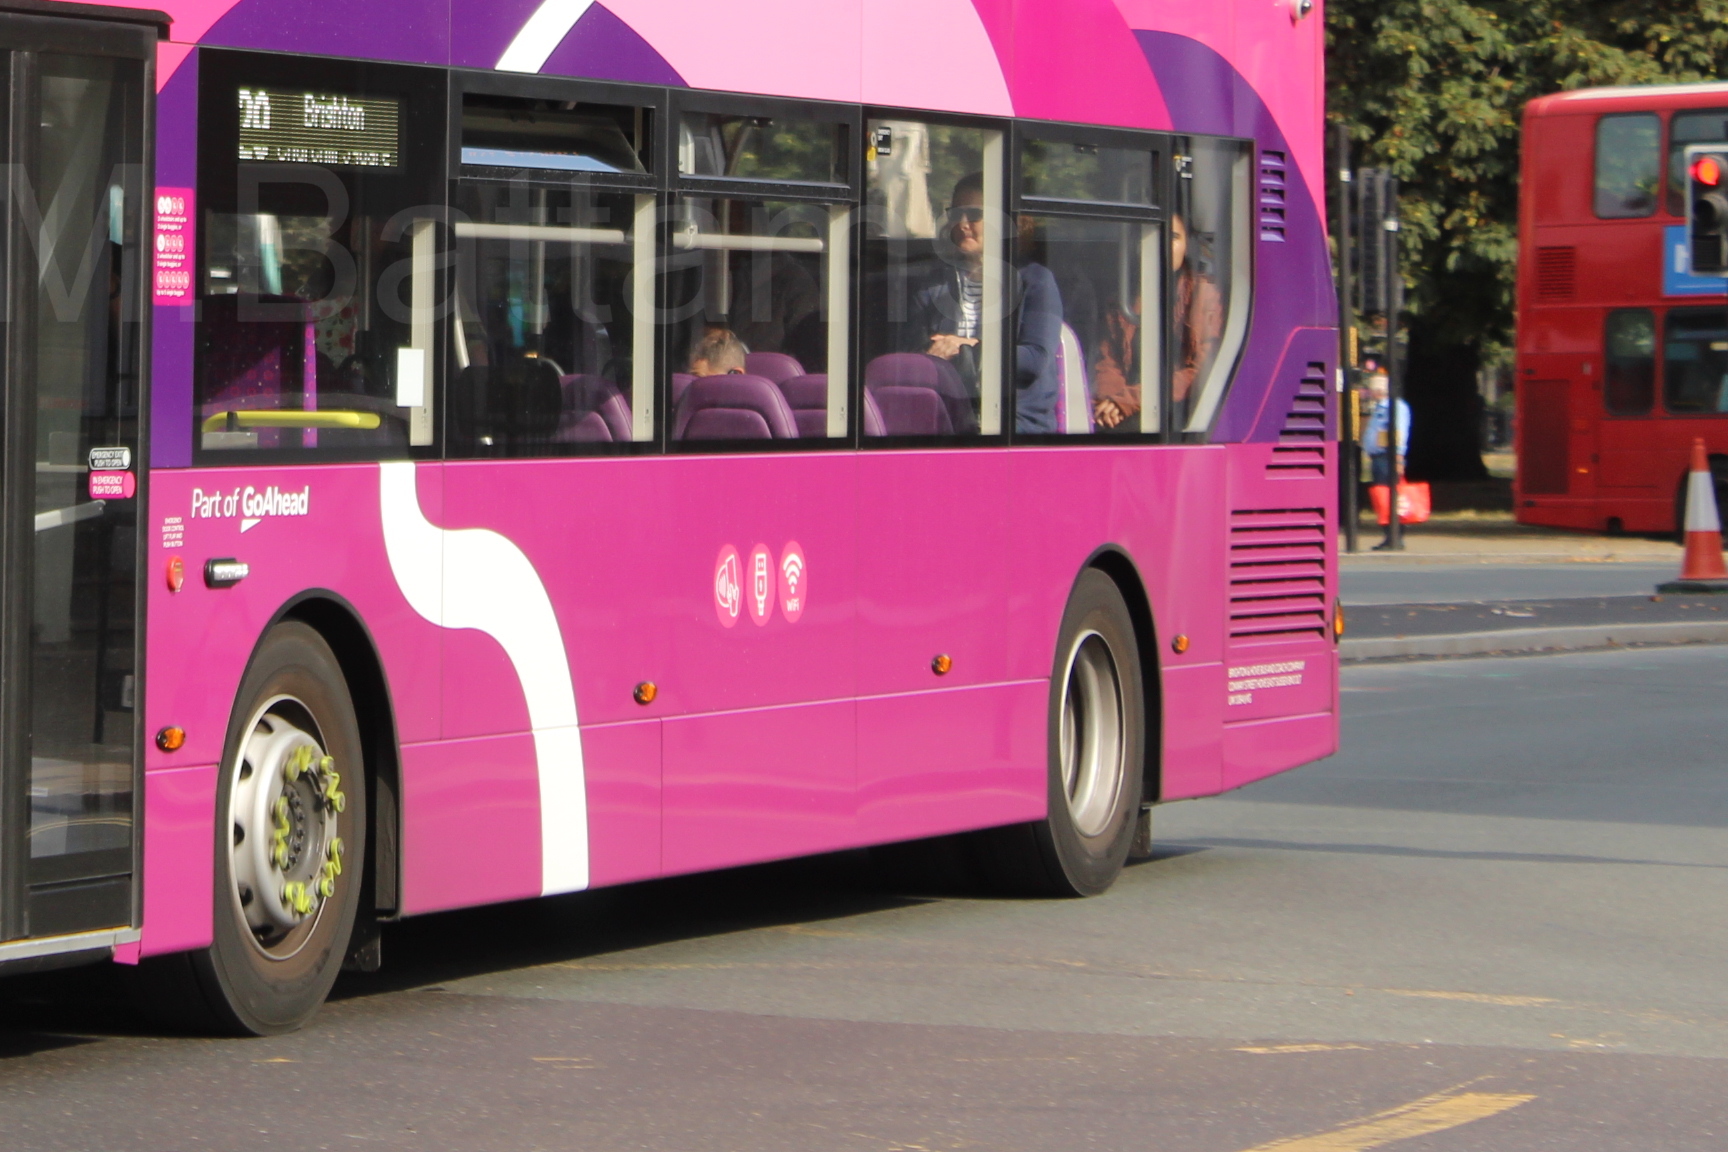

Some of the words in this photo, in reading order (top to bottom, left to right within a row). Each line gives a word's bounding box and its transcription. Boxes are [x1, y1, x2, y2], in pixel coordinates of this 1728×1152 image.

[191, 487, 222, 518] Part
[223, 487, 240, 517] of
[242, 485, 309, 517] GoAhead
